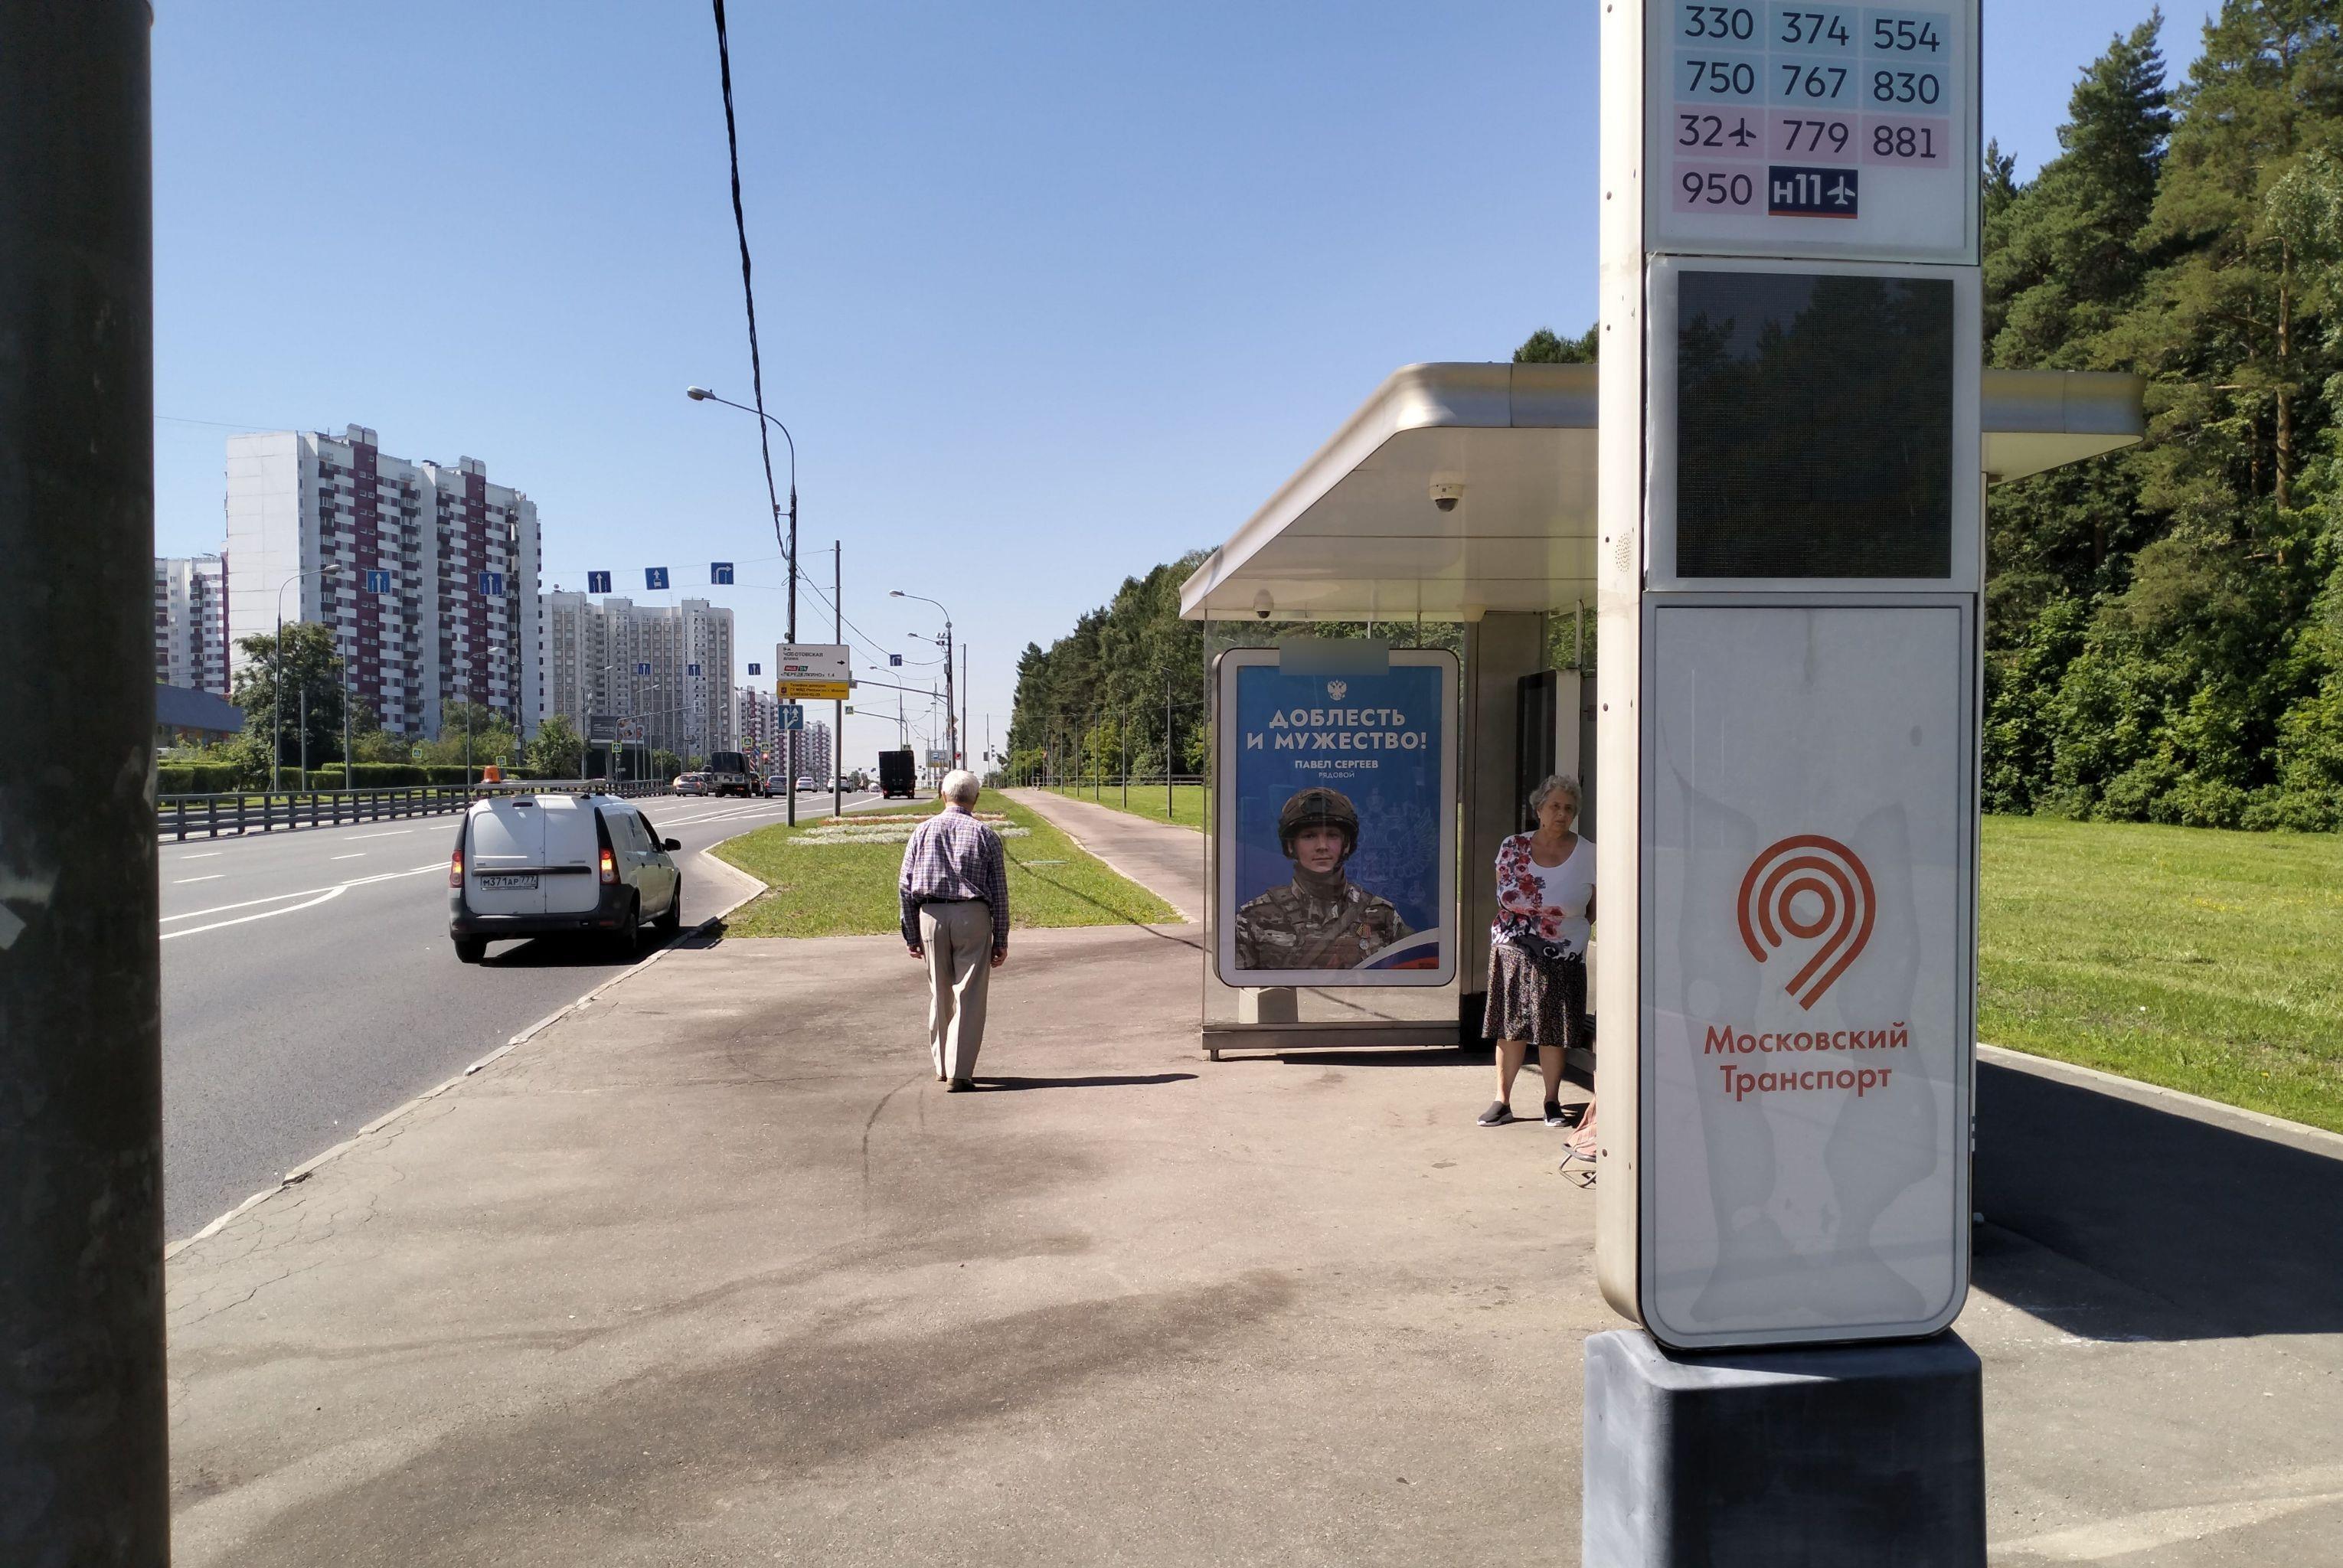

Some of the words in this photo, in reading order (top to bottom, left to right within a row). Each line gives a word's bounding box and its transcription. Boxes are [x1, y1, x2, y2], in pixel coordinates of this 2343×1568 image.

[1685, 6, 1753, 39] 330
[1782, 12, 1849, 45] 374
[1874, 19, 1939, 52] 554
[1687, 60, 1754, 94] 750
[1783, 65, 1847, 97] 767
[1874, 71, 1939, 104] 830
[1679, 115, 1723, 146] 32
[1783, 120, 1848, 152] 779
[1874, 126, 1936, 158] 881
[1683, 172, 1752, 204] 950
[1270, 709, 1404, 728] ДОБЛЕСТЬ
[1247, 733, 1263, 749] И
[1275, 732, 1426, 749] МУЖЕСТВО!
[1704, 1021, 1907, 1054] Московский
[1720, 1065, 1891, 1102] Транспорт
